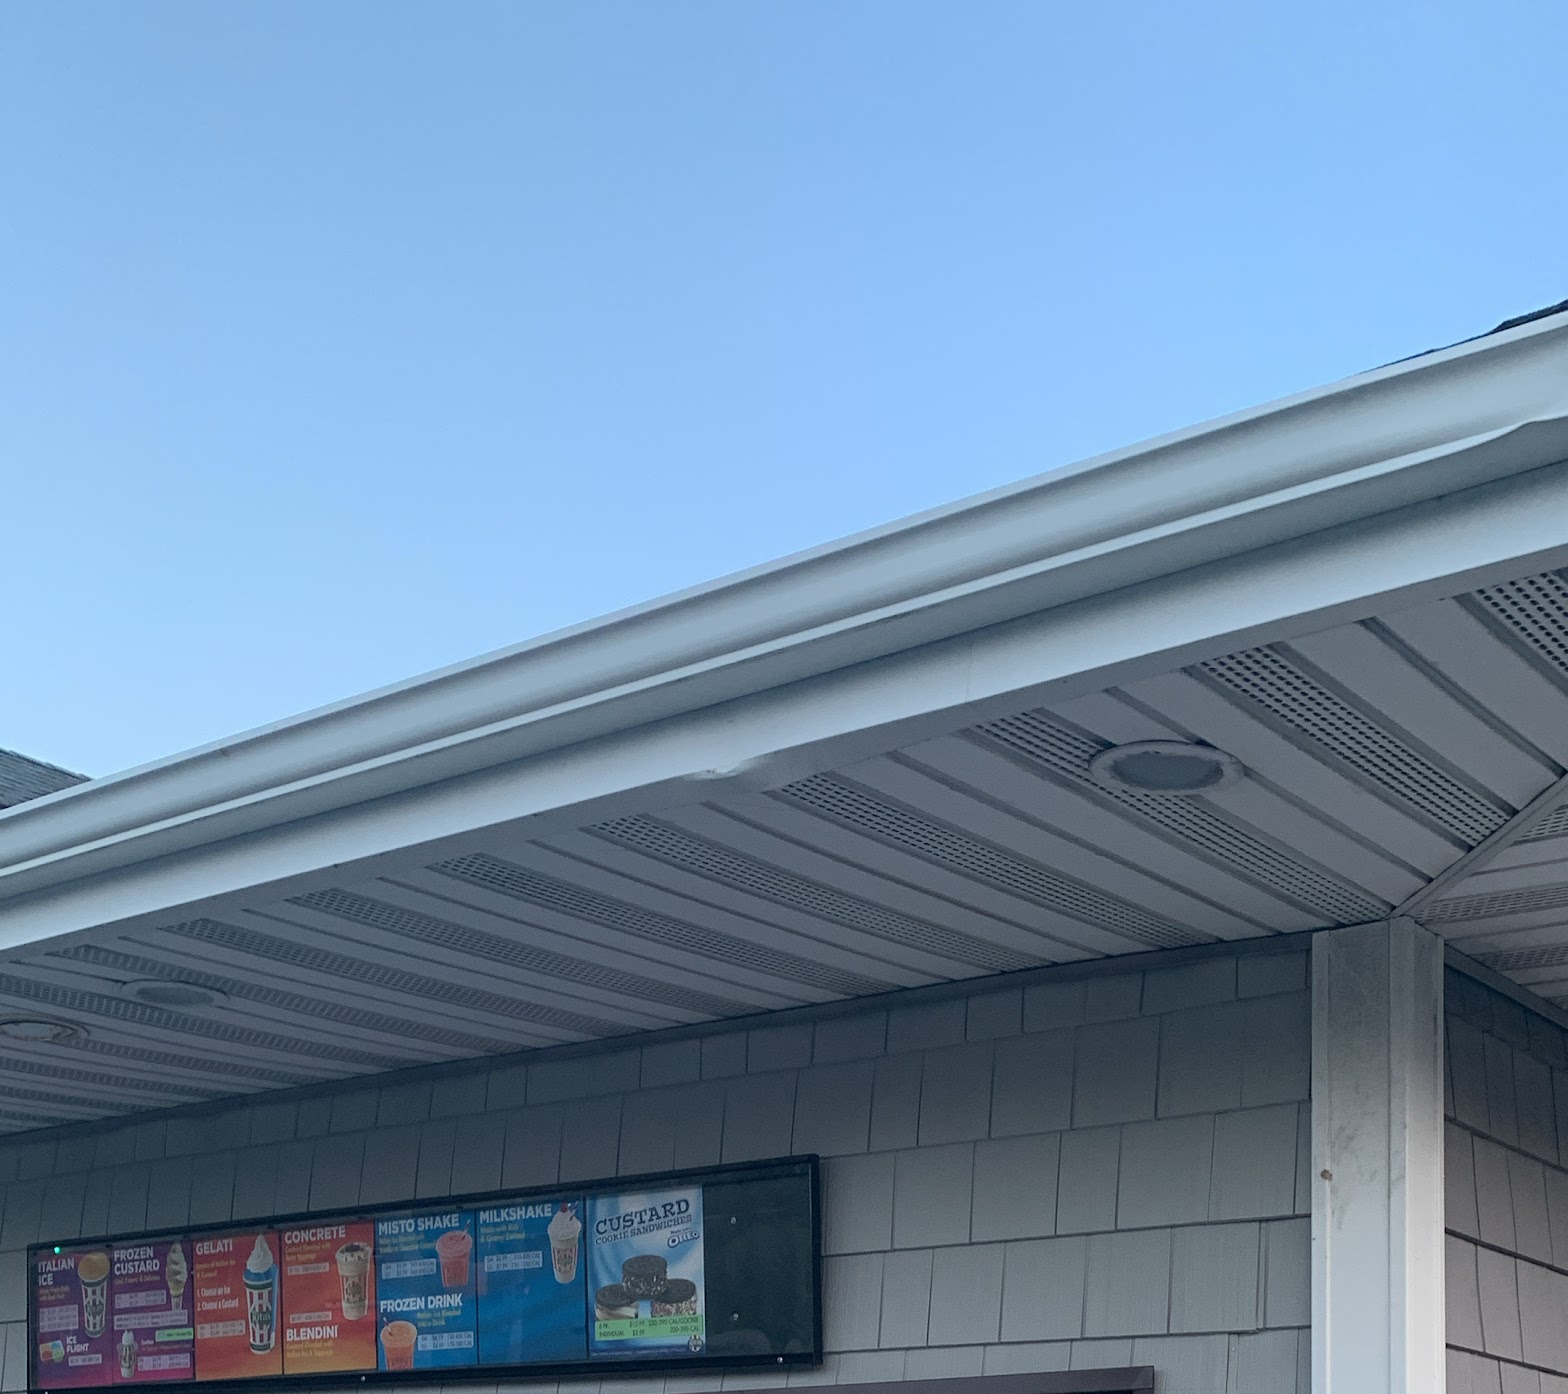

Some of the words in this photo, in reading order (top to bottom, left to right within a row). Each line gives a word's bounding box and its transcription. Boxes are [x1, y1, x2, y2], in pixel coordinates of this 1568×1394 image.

[479, 1203, 552, 1224] MILKSHAKE
[595, 1199, 690, 1235] CUSTARD
[379, 1219, 415, 1235] MISTO
[418, 1214, 459, 1231] SHAKE
[595, 1231, 629, 1245] COOKIE
[630, 1214, 692, 1237] SANDWICHES
[285, 1225, 346, 1244] CONCRETE
[667, 1231, 700, 1248] OREO
[114, 1246, 154, 1262] FROZEN
[196, 1239, 233, 1255] GELATI
[38, 1257, 75, 1273] ITALIAN
[114, 1259, 160, 1276] CUSTARD
[38, 1273, 53, 1287] ICE
[380, 1298, 425, 1313] FROZEN
[428, 1293, 463, 1309] DRINK
[66, 1336, 77, 1344] ICE
[286, 1324, 338, 1342] BLENDINI
[67, 1343, 89, 1353] FLIGHT
